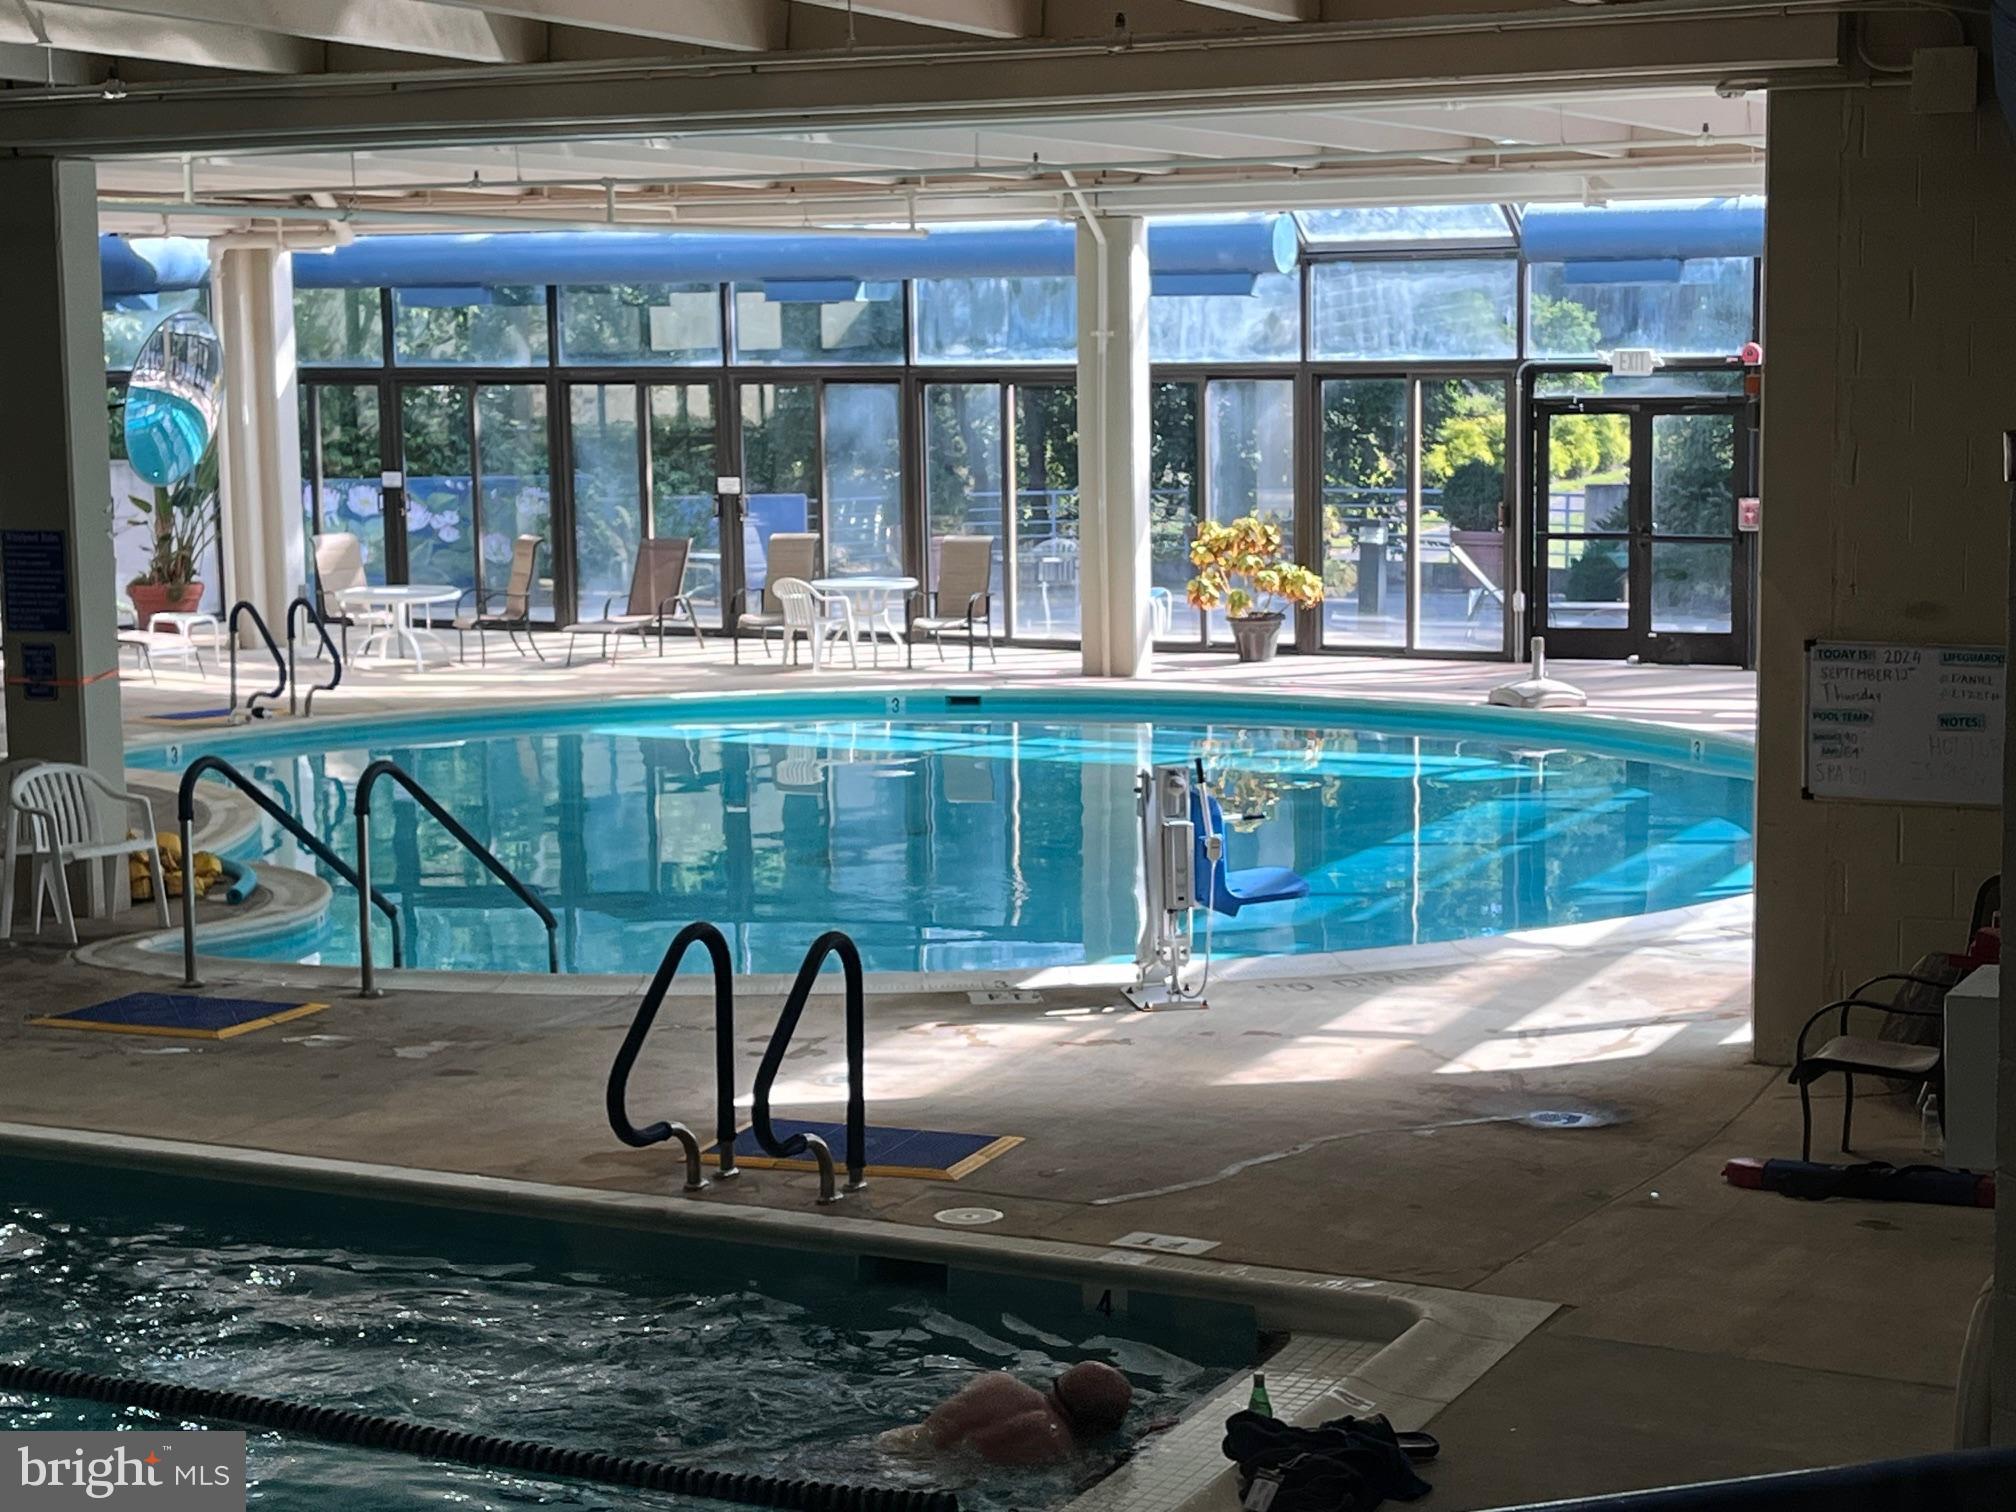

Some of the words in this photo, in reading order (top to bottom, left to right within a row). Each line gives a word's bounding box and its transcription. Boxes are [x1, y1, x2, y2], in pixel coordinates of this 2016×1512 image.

[1619, 351, 1646, 371] EXIT
[1816, 649, 1856, 660] TODAY
[892, 697, 901, 713] 3
[171, 745, 178, 765] 3
[1096, 1289, 1115, 1319] 4
